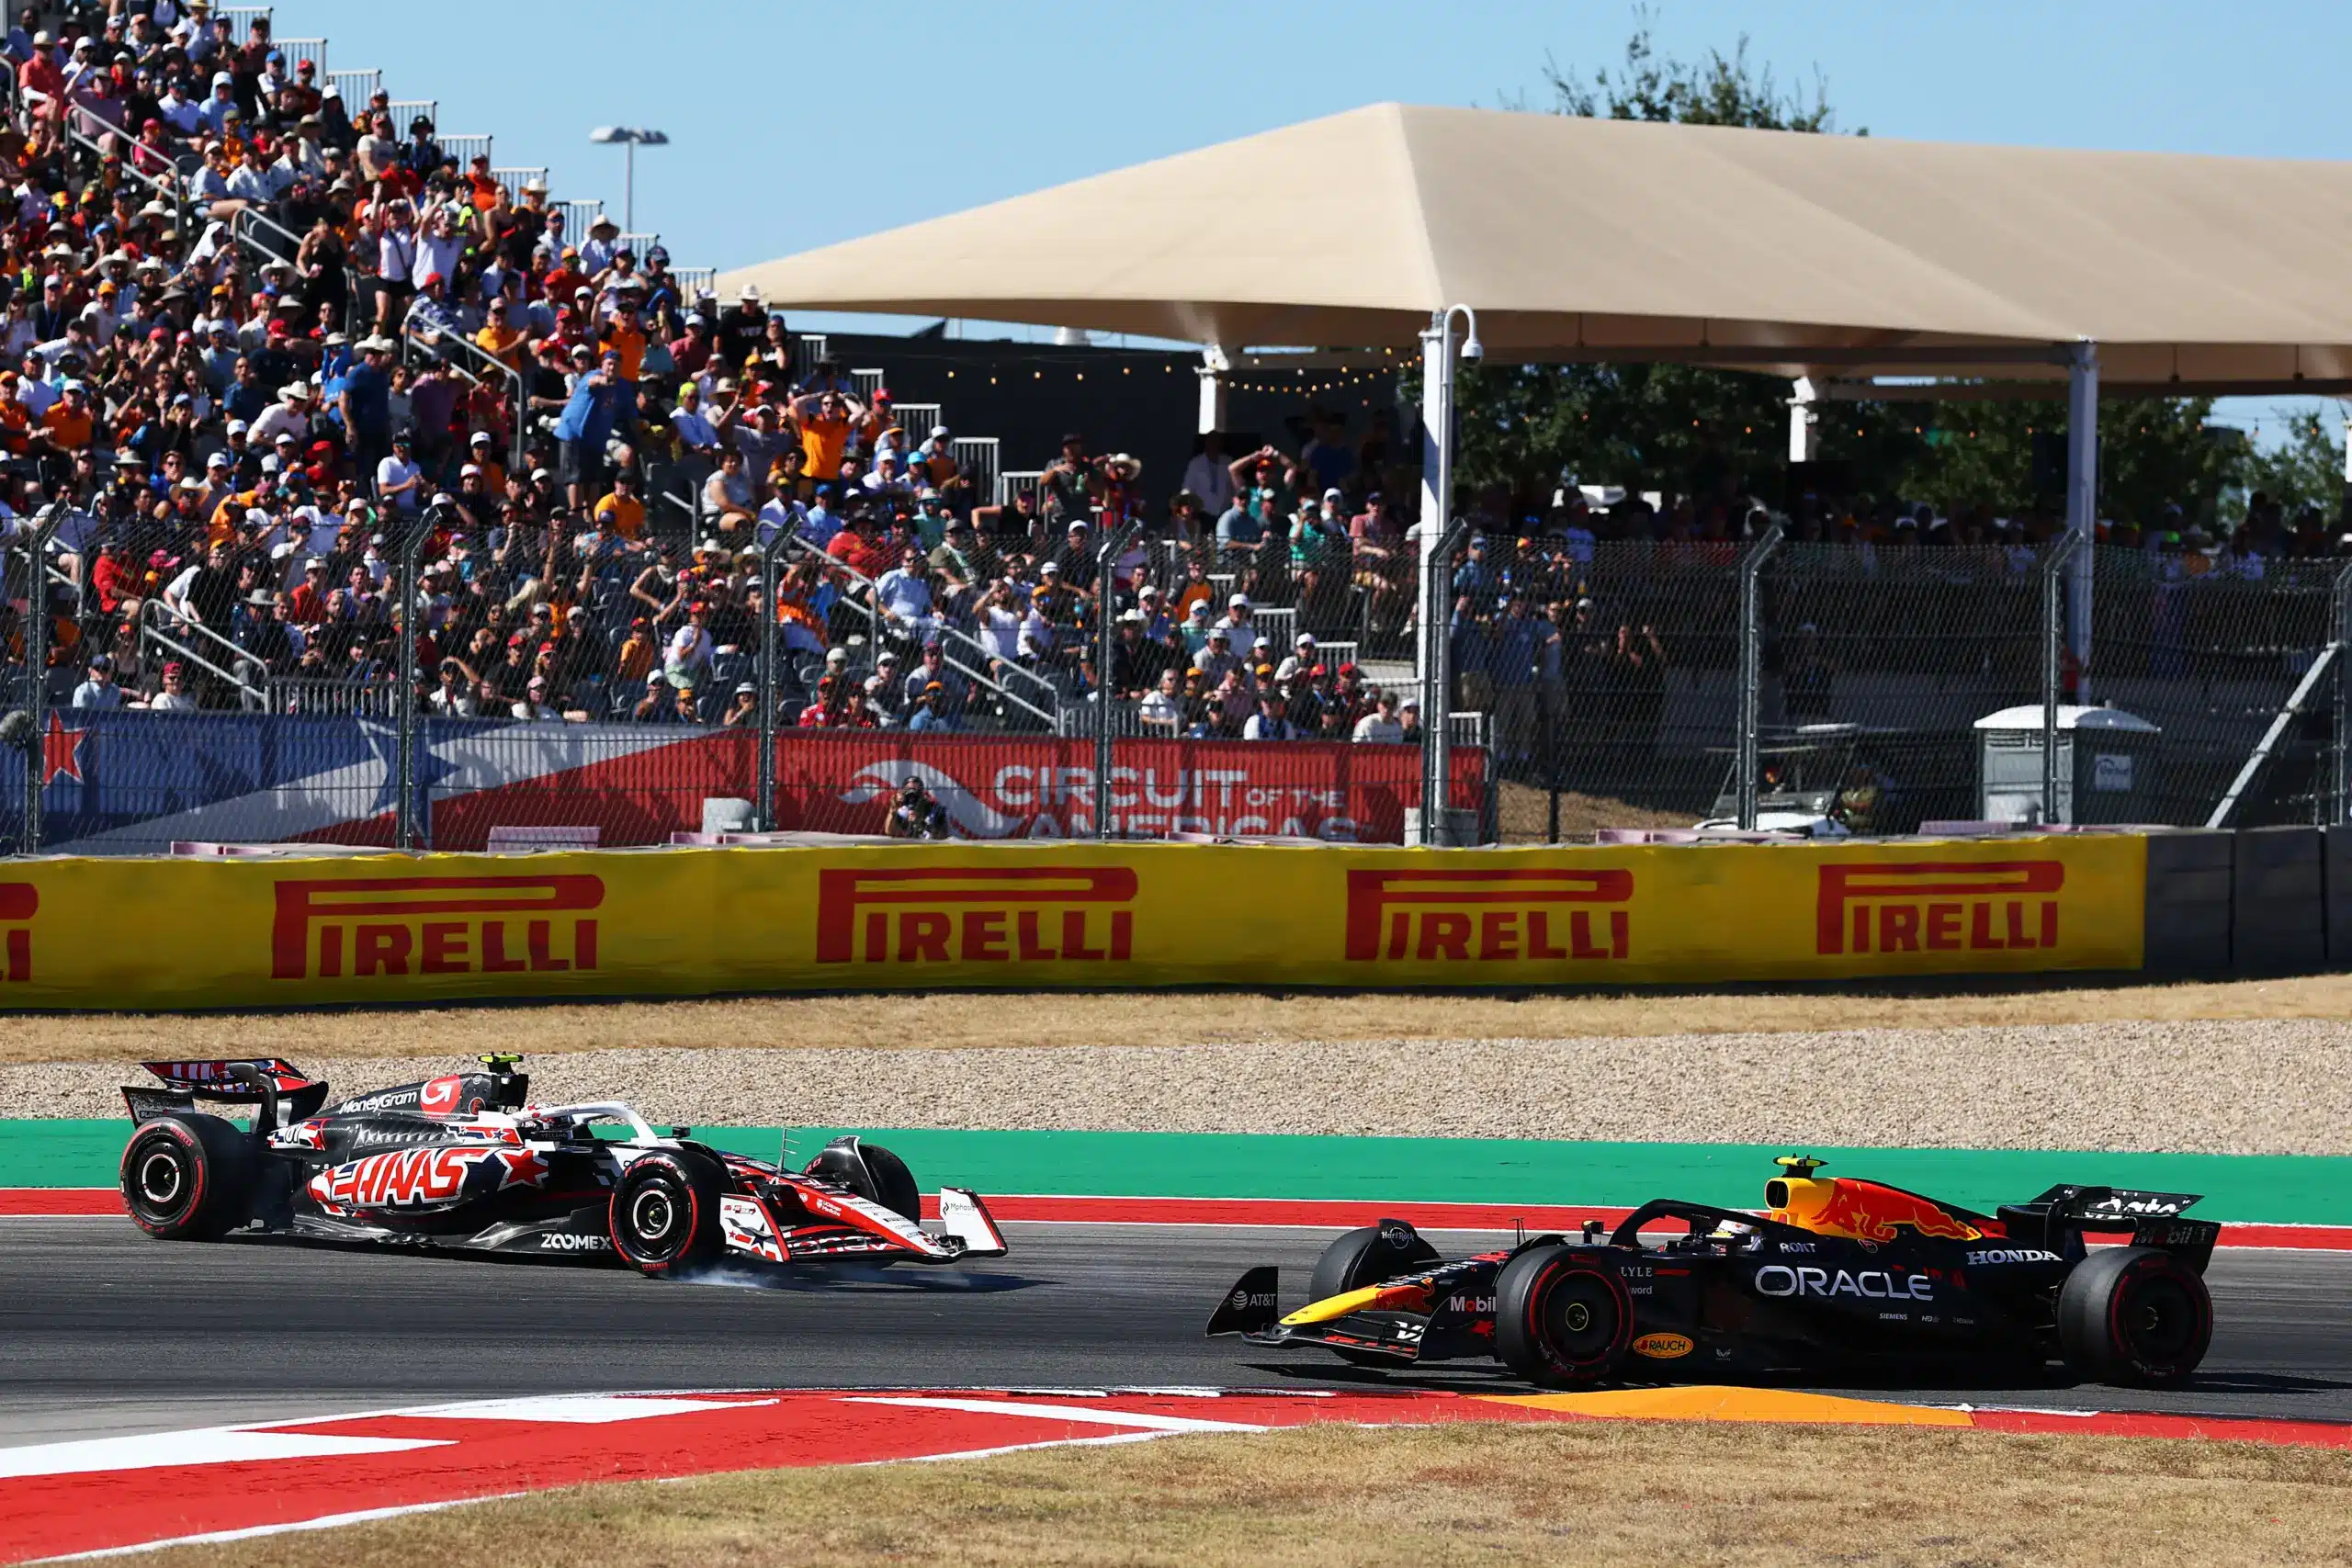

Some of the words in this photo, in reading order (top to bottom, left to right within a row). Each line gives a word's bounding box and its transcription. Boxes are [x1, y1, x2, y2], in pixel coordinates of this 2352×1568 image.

[994, 765, 1248, 808] CIRCUIT
[1245, 787, 1283, 807] OF
[1291, 789, 1345, 807] THE
[816, 866, 1138, 964] PIRELLI
[1344, 869, 1634, 962] PIRELLI
[1816, 860, 2064, 955] PIRELLI
[271, 874, 605, 979] PIRELLI
[338, 1089, 417, 1114] MoneyGram
[331, 1146, 491, 1205] HAAS
[540, 1233, 613, 1250] ZOOMEX
[1966, 1249, 2064, 1266] HONDA
[1620, 1267, 1653, 1277] LYLE
[1755, 1265, 1934, 1302] ORACLE
[1250, 1293, 1276, 1306] AT&T
[1450, 1295, 1497, 1313] Mobil
[1879, 1313, 1908, 1321] SIEMENS
[1648, 1339, 1686, 1351] RAUCH
